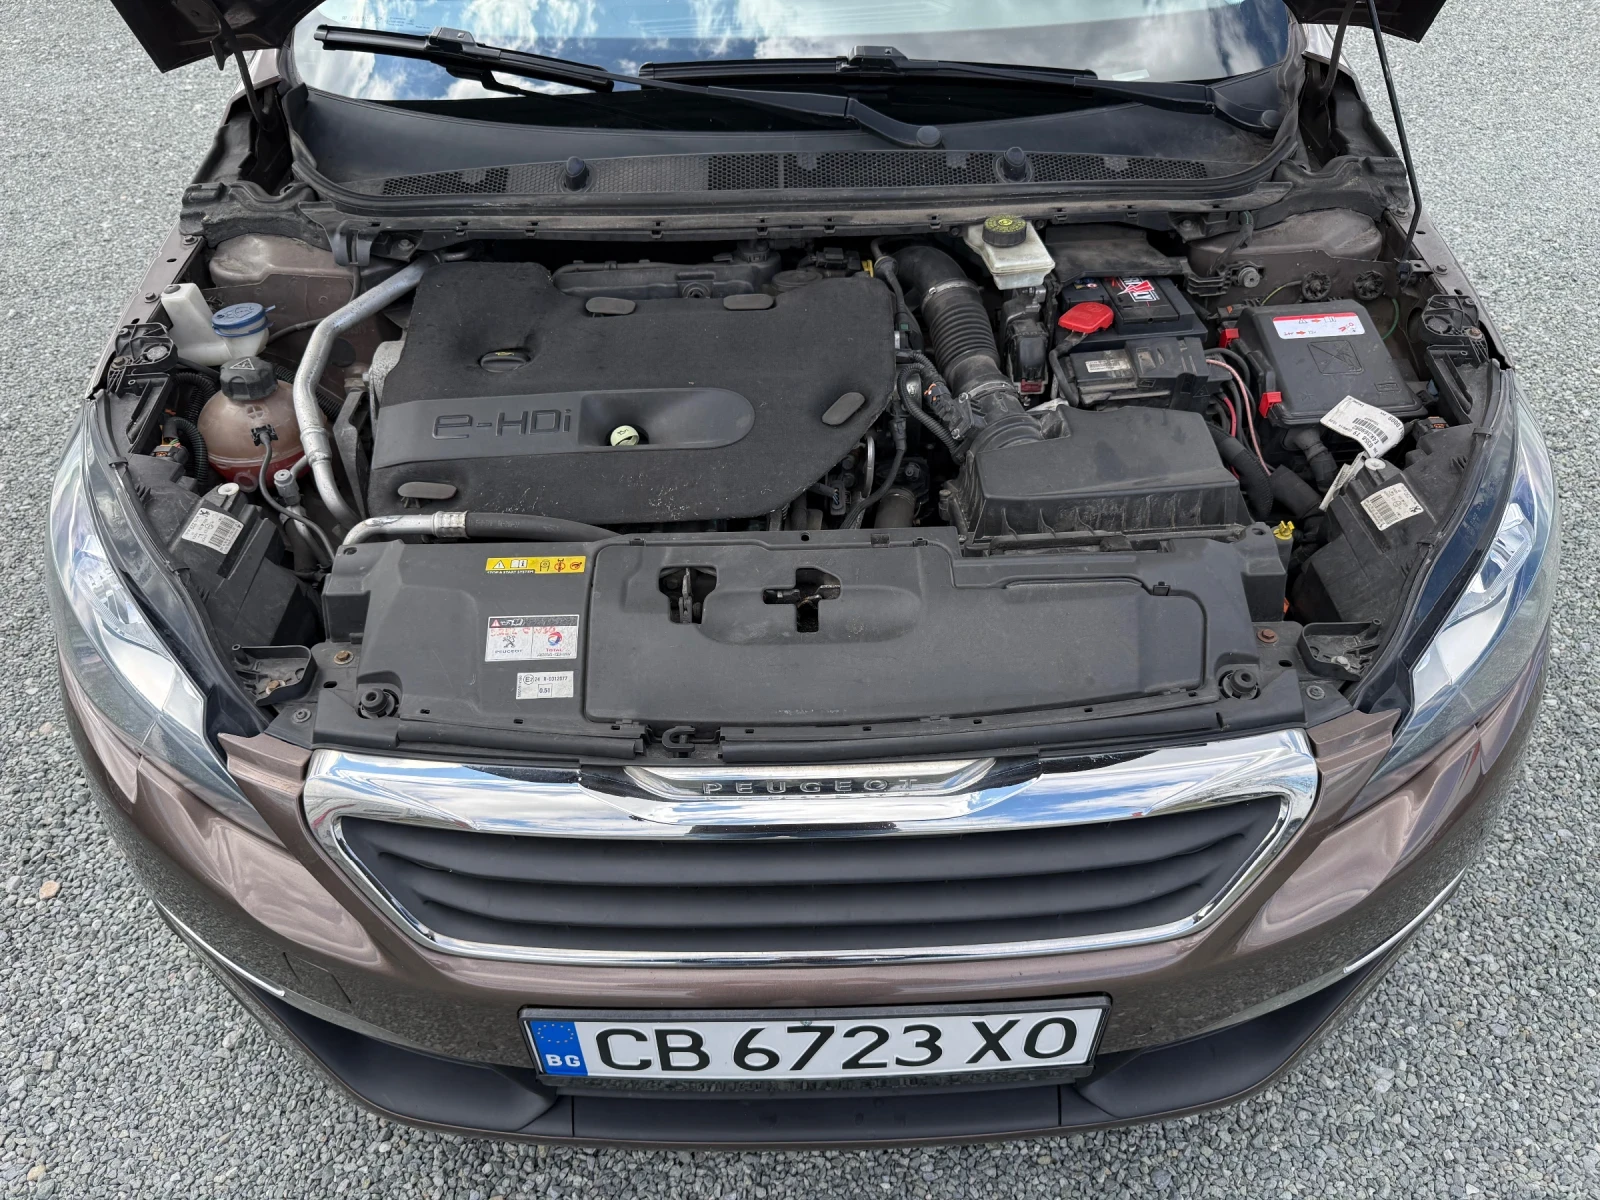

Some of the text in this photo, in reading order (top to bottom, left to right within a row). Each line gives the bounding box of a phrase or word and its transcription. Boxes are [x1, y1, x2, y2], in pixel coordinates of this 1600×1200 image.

[432, 408, 572, 440] e-HDi
[703, 778, 918, 795] PEUGEOT
[545, 1017, 1078, 1073] BG CB 6723 XO
